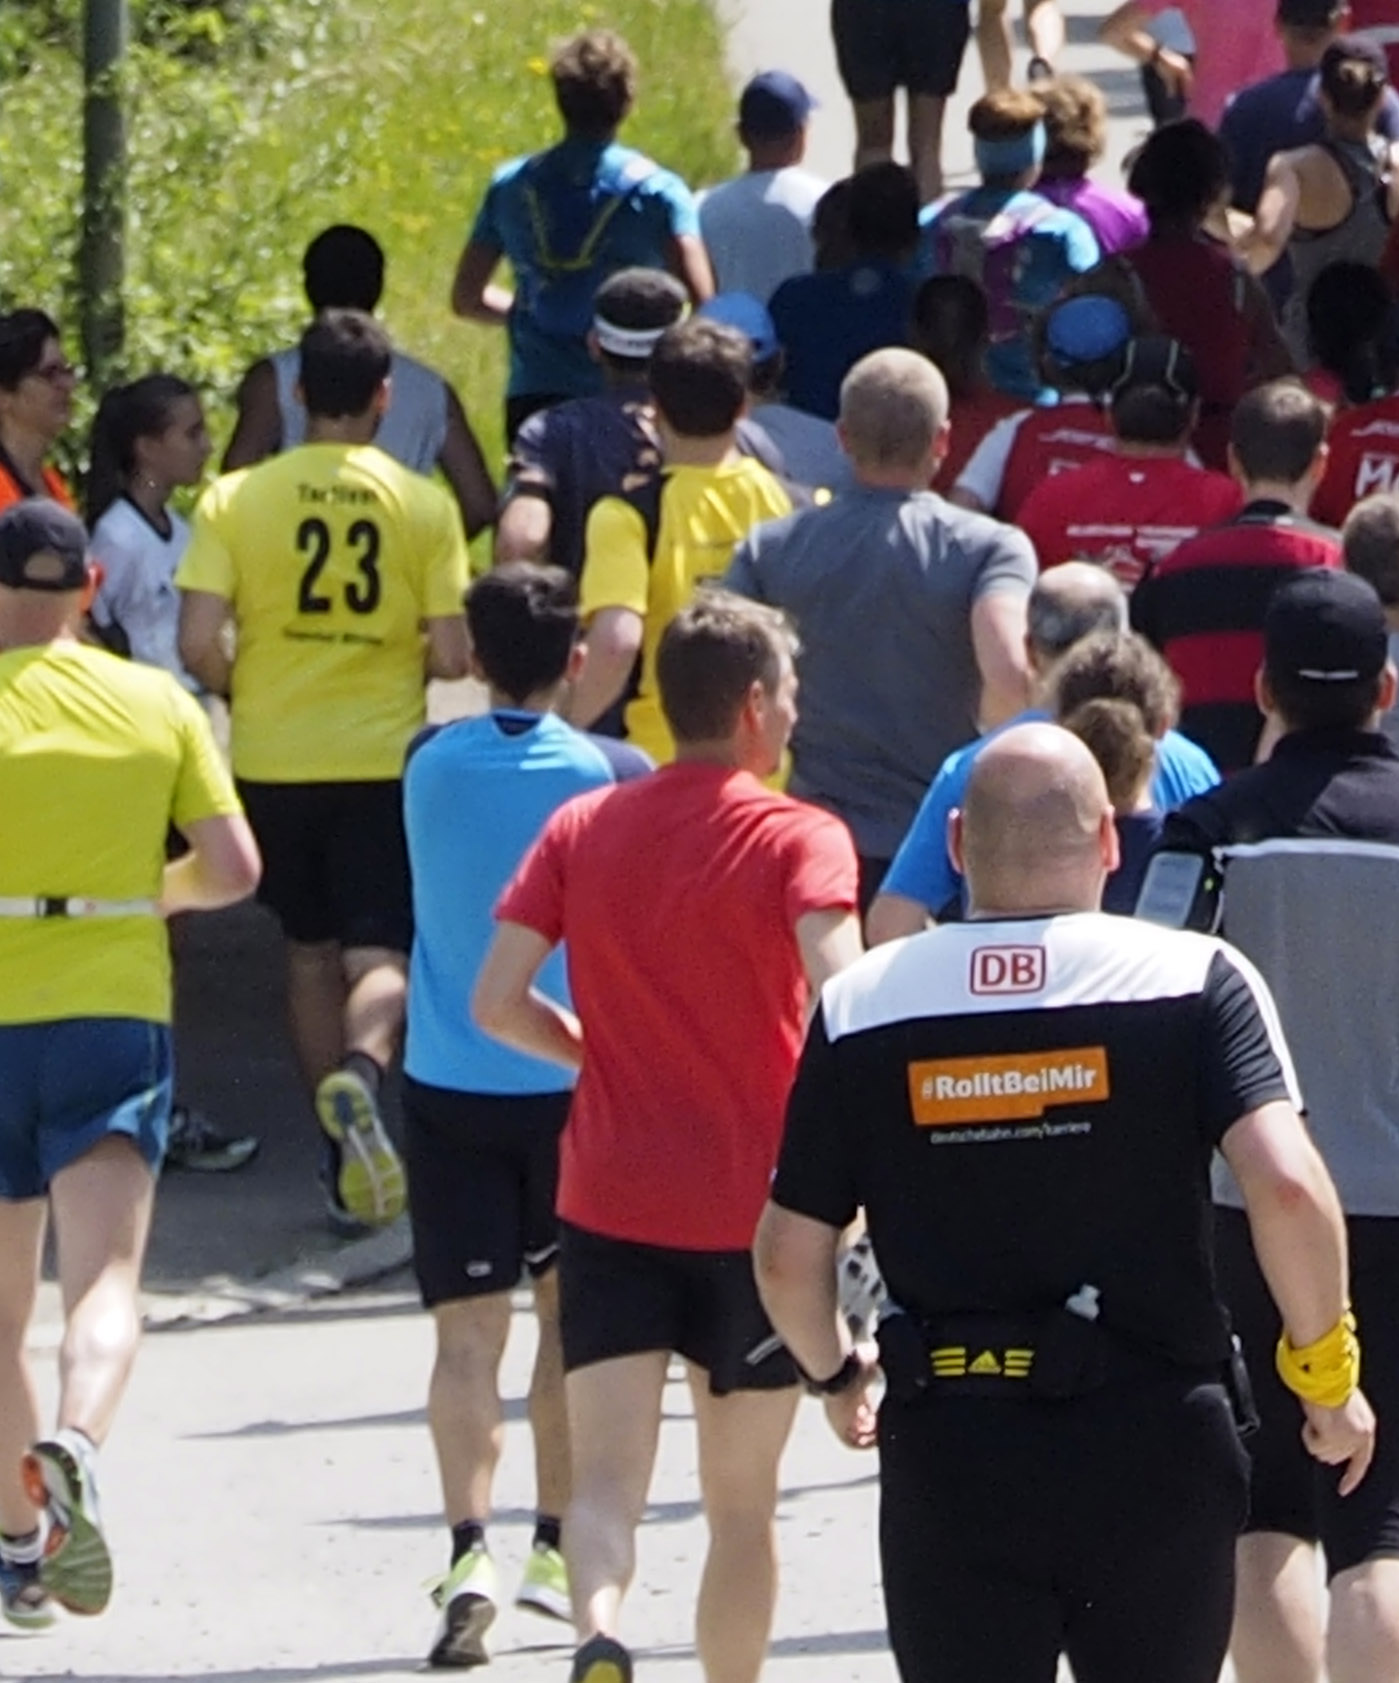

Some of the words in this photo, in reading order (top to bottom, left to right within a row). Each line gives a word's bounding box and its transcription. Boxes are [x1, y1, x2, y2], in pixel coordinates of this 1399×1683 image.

[298, 517, 381, 614] 23
[979, 952, 1037, 987] DB
[921, 1063, 1097, 1100] #RolltBeiMir
